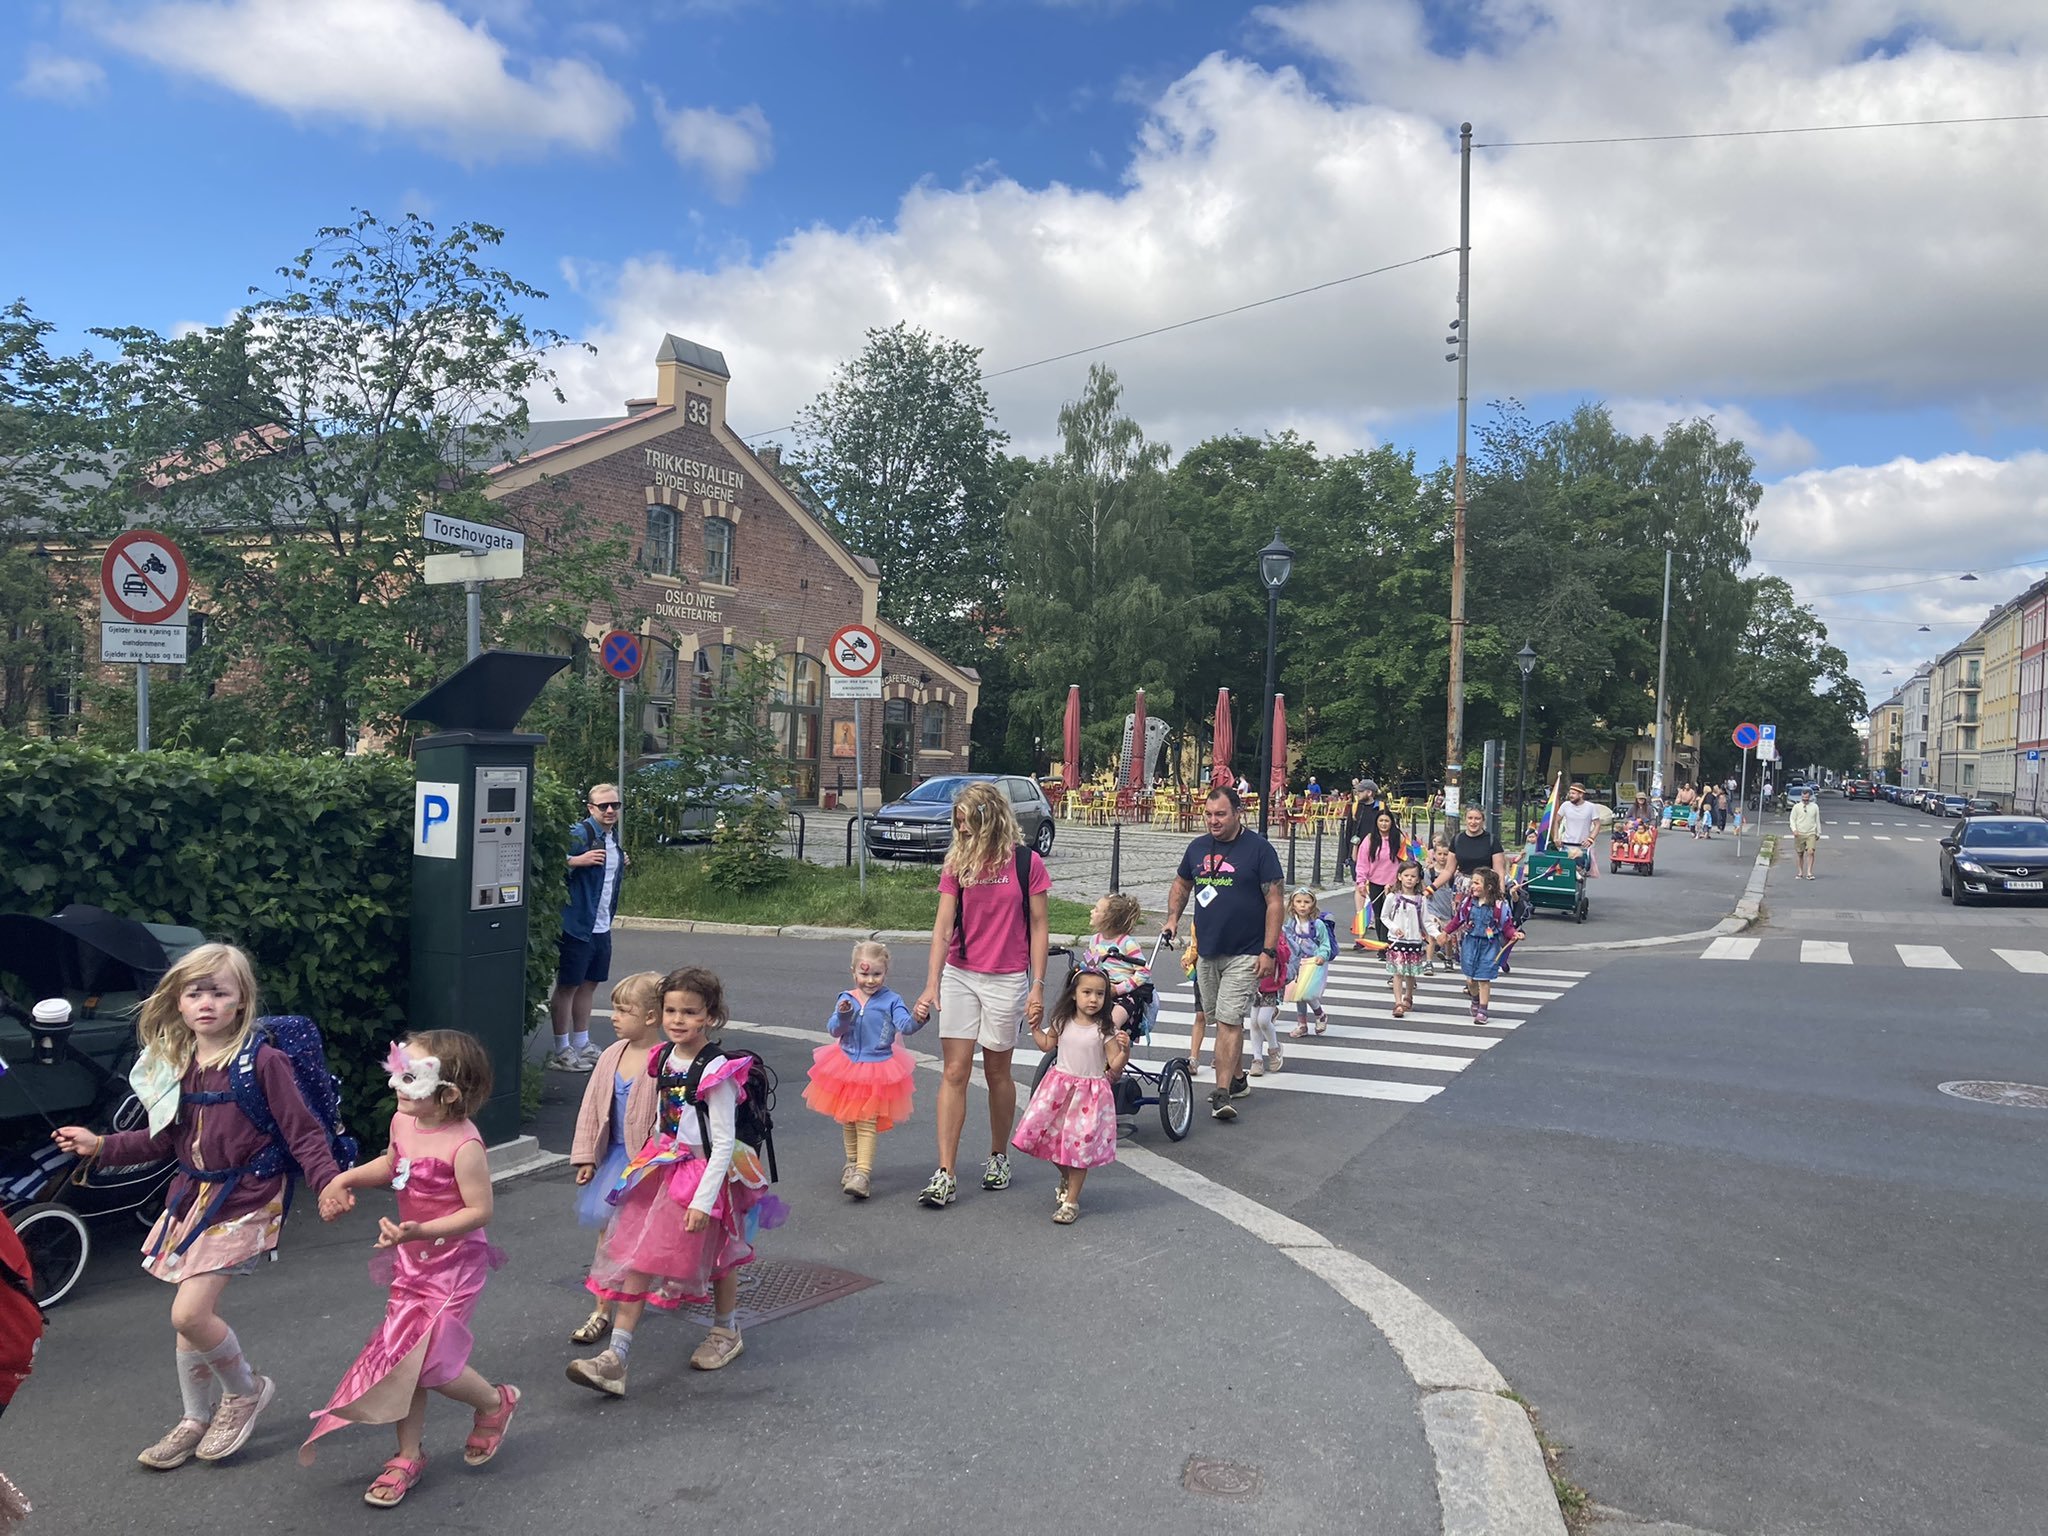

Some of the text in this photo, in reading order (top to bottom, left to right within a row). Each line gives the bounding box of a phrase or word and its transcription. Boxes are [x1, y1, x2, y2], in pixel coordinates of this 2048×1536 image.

[689, 400, 709, 425] 33
[645, 448, 744, 490] TRIKKESTALLEN
[655, 472, 734, 503] BYDEL SAGENE
[433, 518, 513, 549] Torshovgata
[665, 589, 716, 609] OSLO NYE
[655, 603, 722, 623] DUKKETEATRET
[108, 625, 131, 634] Gjelder
[104, 650, 127, 658] Gjelder
[1762, 727, 1772, 738] P
[2029, 751, 2037, 760] P
[422, 794, 450, 844] P
